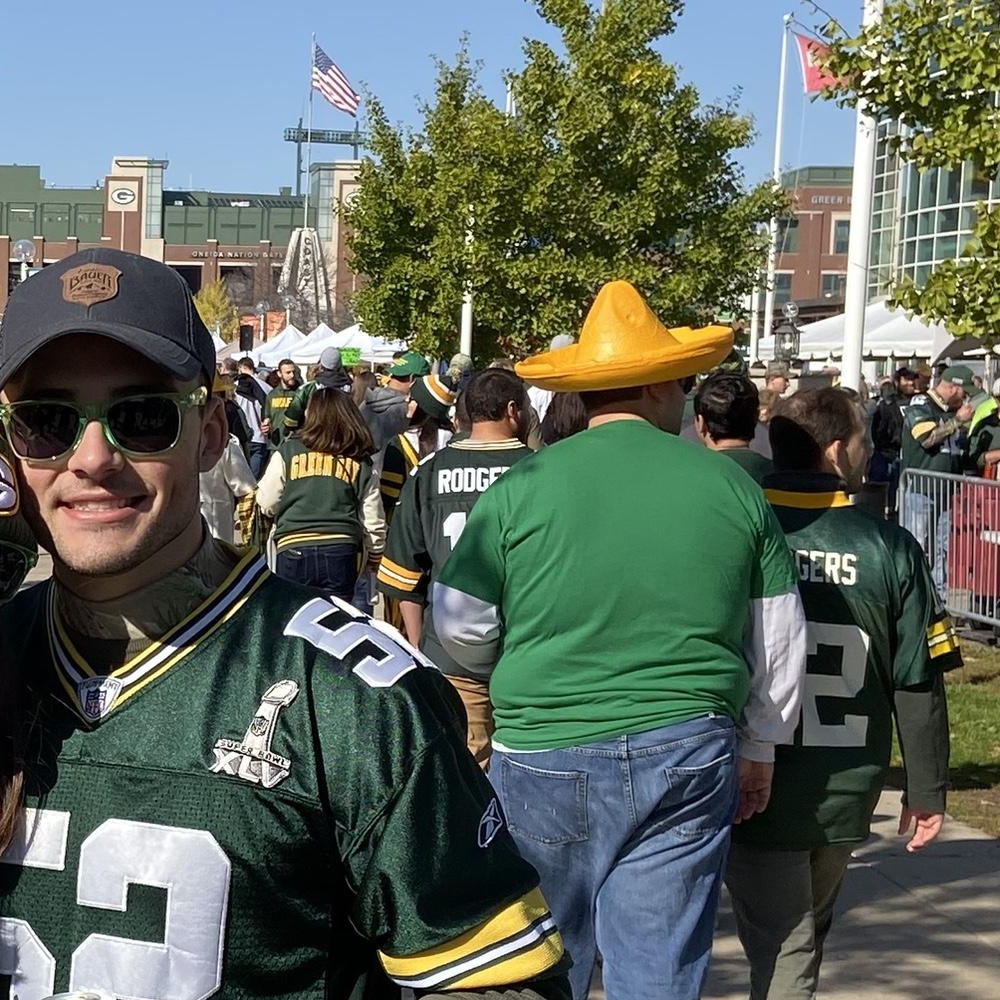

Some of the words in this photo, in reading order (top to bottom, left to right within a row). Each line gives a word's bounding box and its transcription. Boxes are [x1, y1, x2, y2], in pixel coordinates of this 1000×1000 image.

[811, 195, 843, 205] GREEN
[192, 250, 223, 258] ONEIDA
[290, 451, 334, 481] GREEN
[438, 466, 511, 494] RODGE
[795, 549, 856, 586] GERS
[219, 739, 254, 756] SUPER
[257, 750, 287, 766] BOWL
